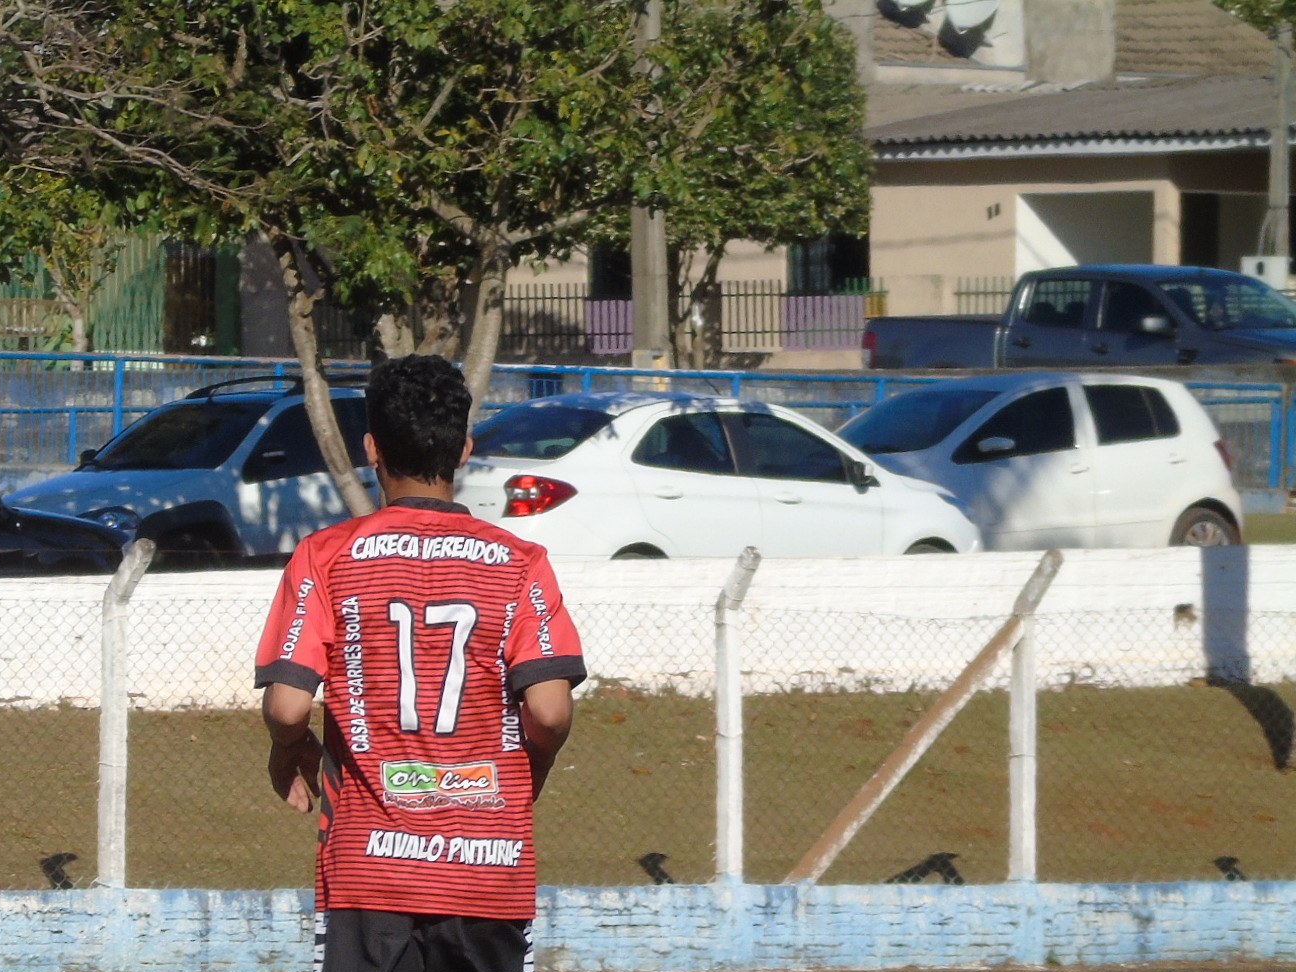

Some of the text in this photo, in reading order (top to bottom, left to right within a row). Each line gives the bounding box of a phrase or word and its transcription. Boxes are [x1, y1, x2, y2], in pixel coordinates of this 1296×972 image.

[351, 534, 510, 564] CARECA VEREADOR
[281, 617, 306, 660] LOJAS
[342, 596, 371, 753] CASA DE CARNES SOUZA
[389, 601, 478, 735] 17
[366, 830, 445, 862] KAVALO
